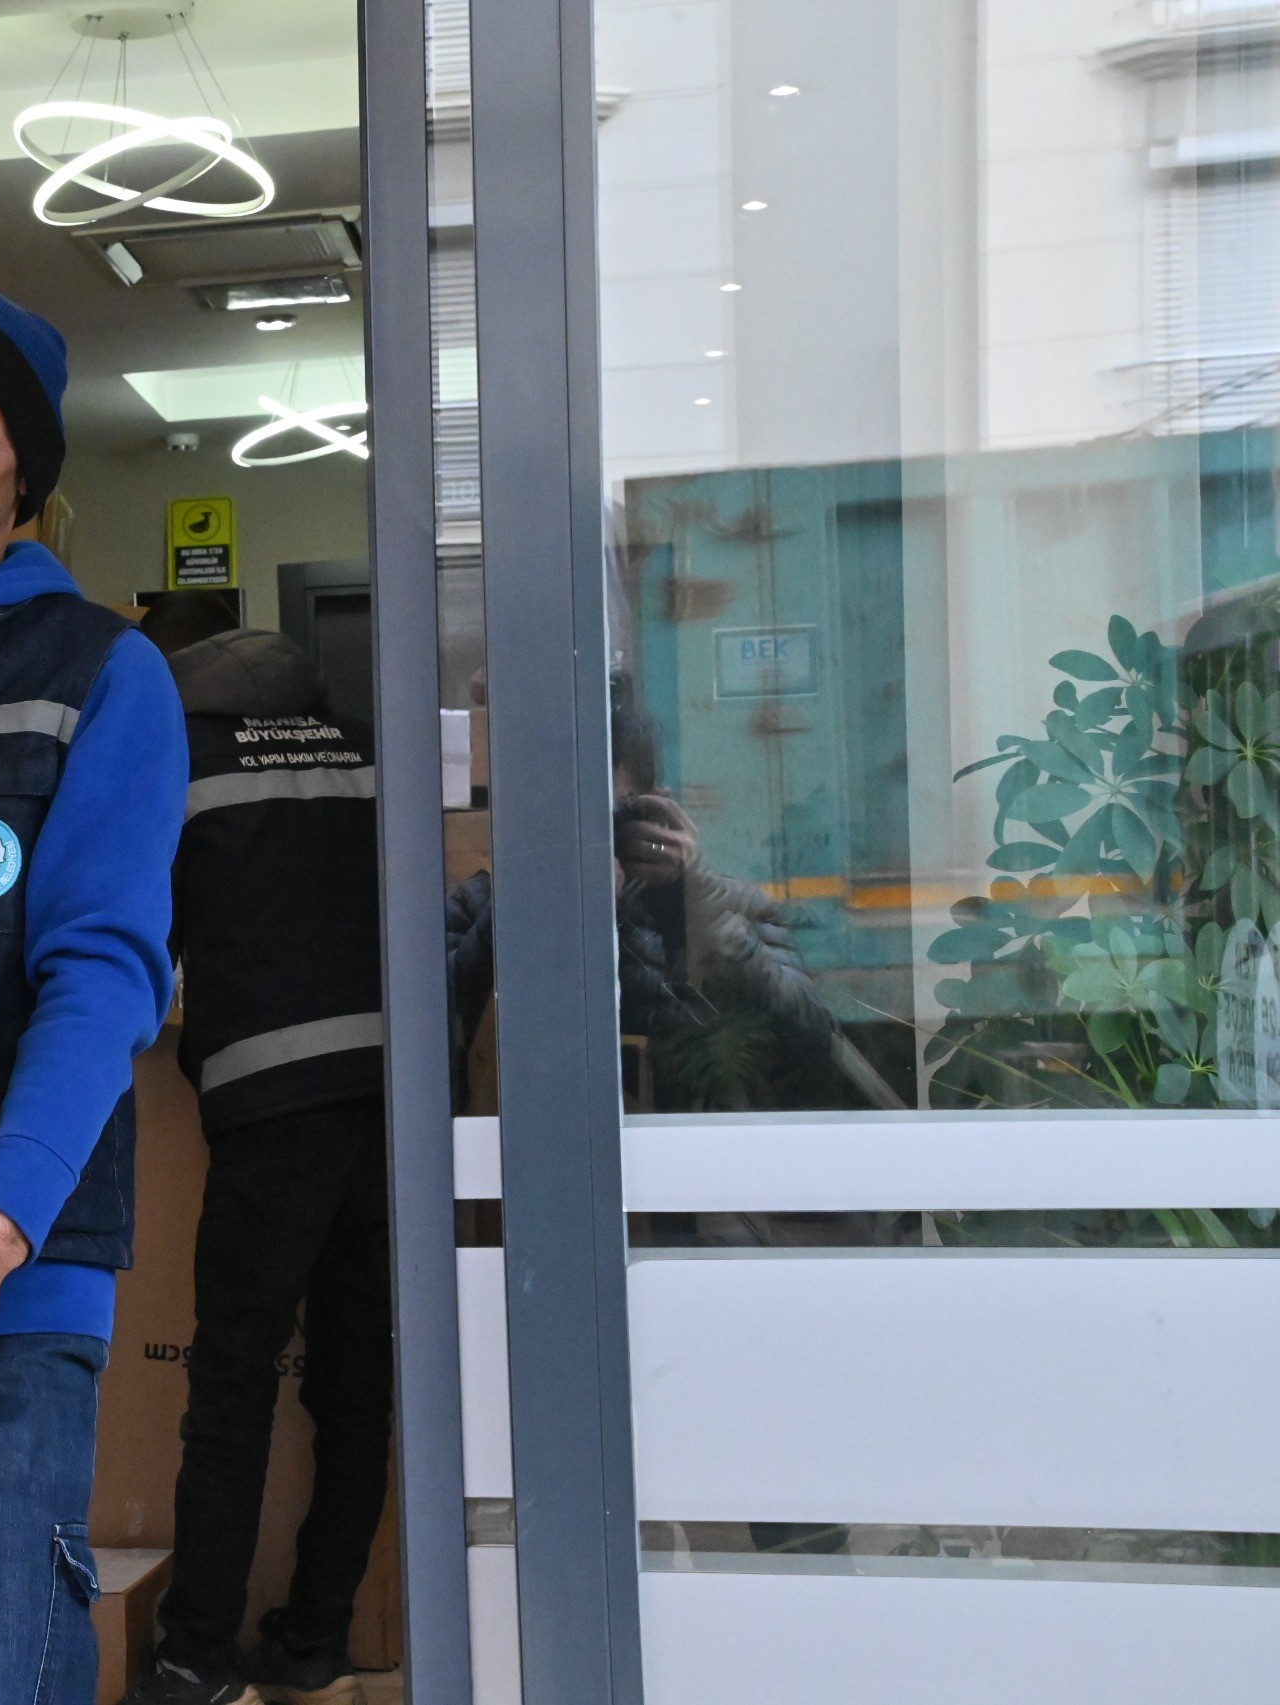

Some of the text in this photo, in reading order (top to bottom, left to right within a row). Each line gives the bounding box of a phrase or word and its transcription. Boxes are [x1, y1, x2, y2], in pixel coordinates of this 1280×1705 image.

[234, 724, 344, 743] BÜYÜKŞEHİR
[239, 752, 363, 767] YOL YAPIM BAKIM VE ONARIM
